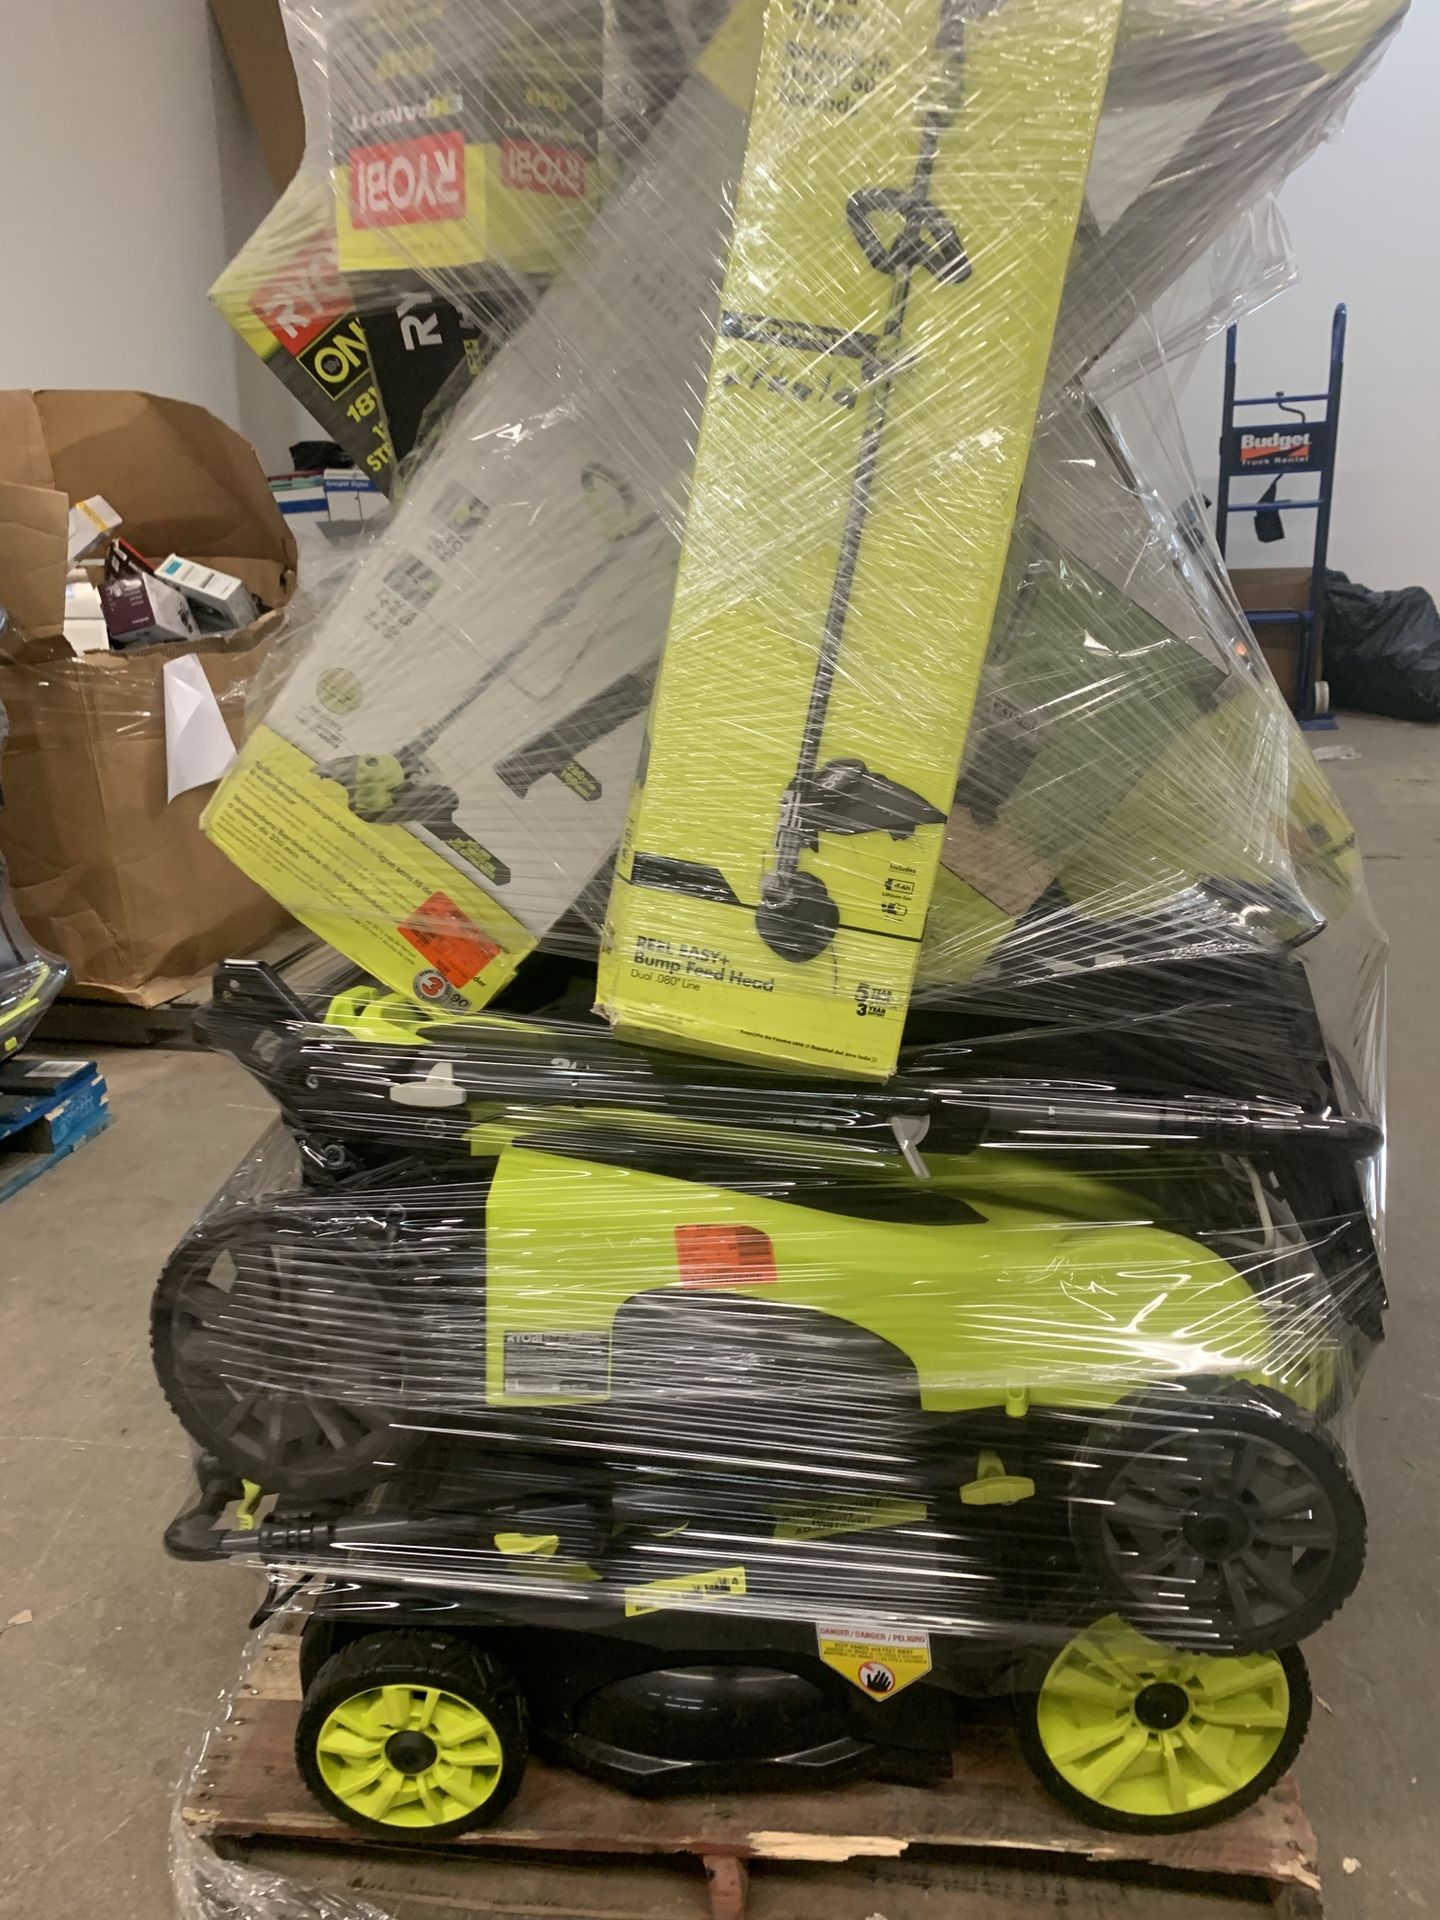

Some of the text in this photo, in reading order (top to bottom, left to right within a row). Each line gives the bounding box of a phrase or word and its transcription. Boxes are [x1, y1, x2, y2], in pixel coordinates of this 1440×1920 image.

[358, 148, 460, 215] RYOBI
[1241, 433, 1312, 451] Budget
[1242, 456, 1309, 466] Truck Rental
[890, 863, 917, 874] Includes
[636, 935, 675, 956] REEL
[679, 944, 730, 965] EASY+
[630, 968, 652, 980] Dual
[682, 979, 701, 992] Line
[633, 951, 774, 992] Bump Feed Head
[421, 976, 445, 996] 3
[854, 982, 870, 1002] 5
[450, 993, 469, 1008] 90
[856, 1002, 867, 1017] 3
[868, 1005, 886, 1014] YEAR
[820, 1627, 850, 1637] DANGER
[855, 1630, 887, 1640] DANGER
[893, 1634, 926, 1643] PELIGRO
